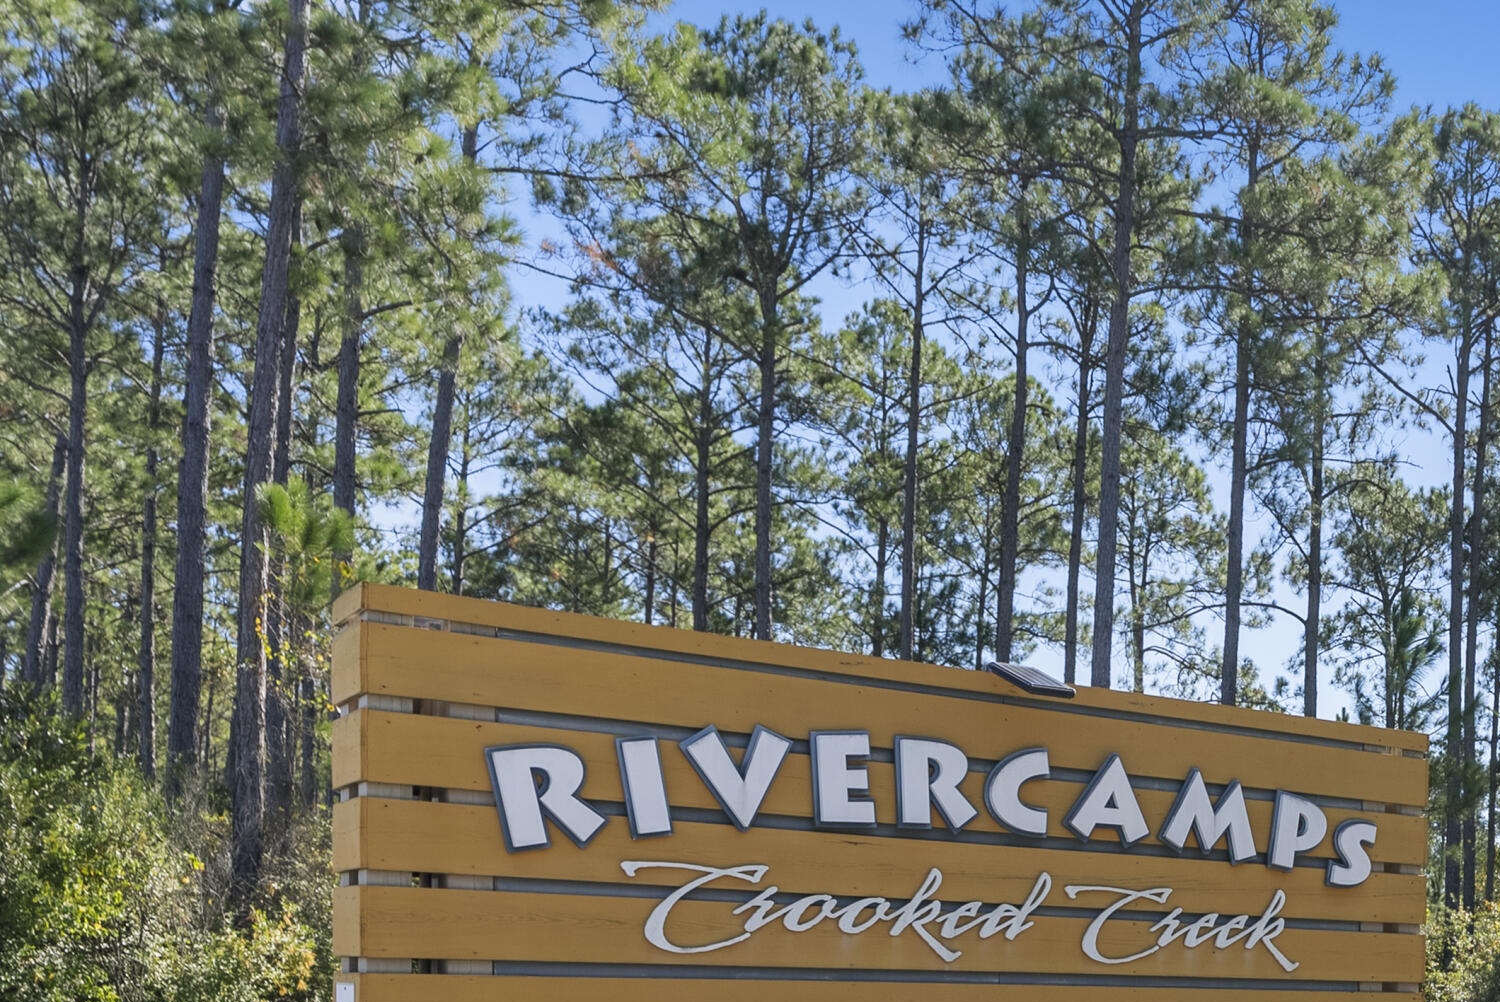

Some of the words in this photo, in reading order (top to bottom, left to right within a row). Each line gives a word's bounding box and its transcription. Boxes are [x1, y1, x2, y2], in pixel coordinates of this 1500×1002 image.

[484, 724, 1379, 888] RIVERCAMPS
[620, 860, 1052, 962] Crooked
[1065, 886, 1300, 972] Creek
